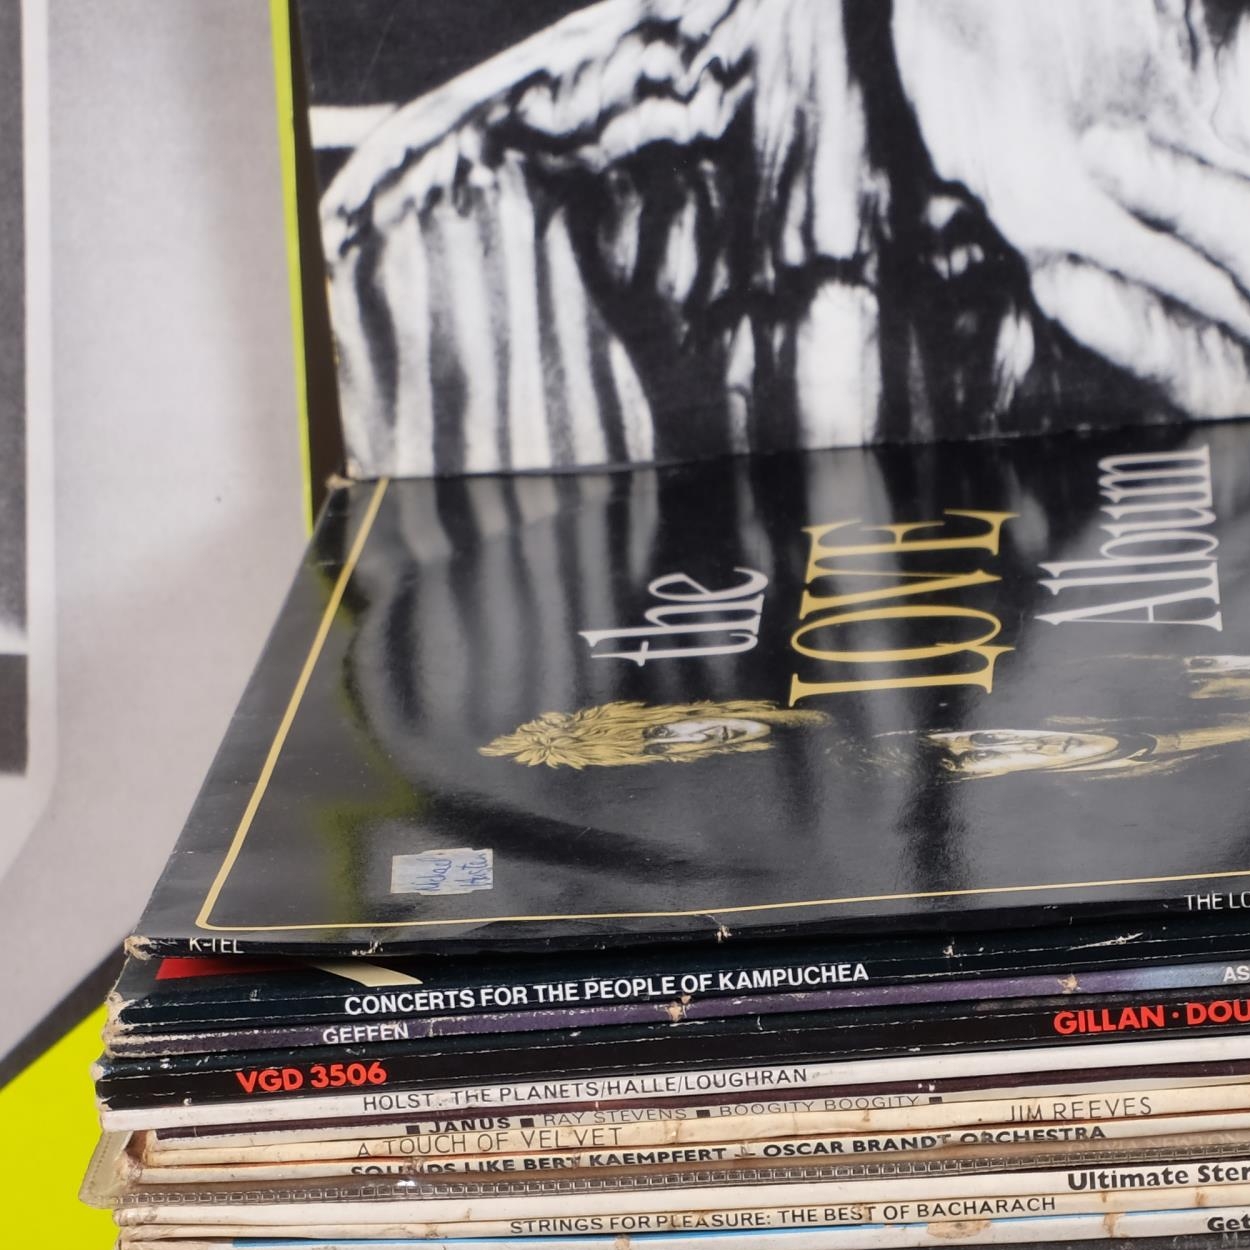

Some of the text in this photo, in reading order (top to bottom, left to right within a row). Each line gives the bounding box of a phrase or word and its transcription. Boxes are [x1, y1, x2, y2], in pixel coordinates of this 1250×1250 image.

[789, 510, 1020, 708] LOVE
[1184, 894, 1224, 911] THE
[344, 963, 869, 1016] CONCERTS FOR THE PEOPLE OF KAMPUCHEA
[322, 1024, 409, 1044] GEFFEN
[1053, 1006, 1164, 1035] GILLAN
[236, 1062, 387, 1094] VGD 3506
[1010, 1097, 1152, 1122] JIM REEVES
[357, 1143, 369, 1158] A
[382, 1134, 469, 1156] TOUCH
[478, 1133, 513, 1152] OF
[1068, 1169, 1189, 1191] Ultimate
[510, 1196, 1056, 1235] STRINGS FOR PLEASURE: THE BEST OF BACHARACH
